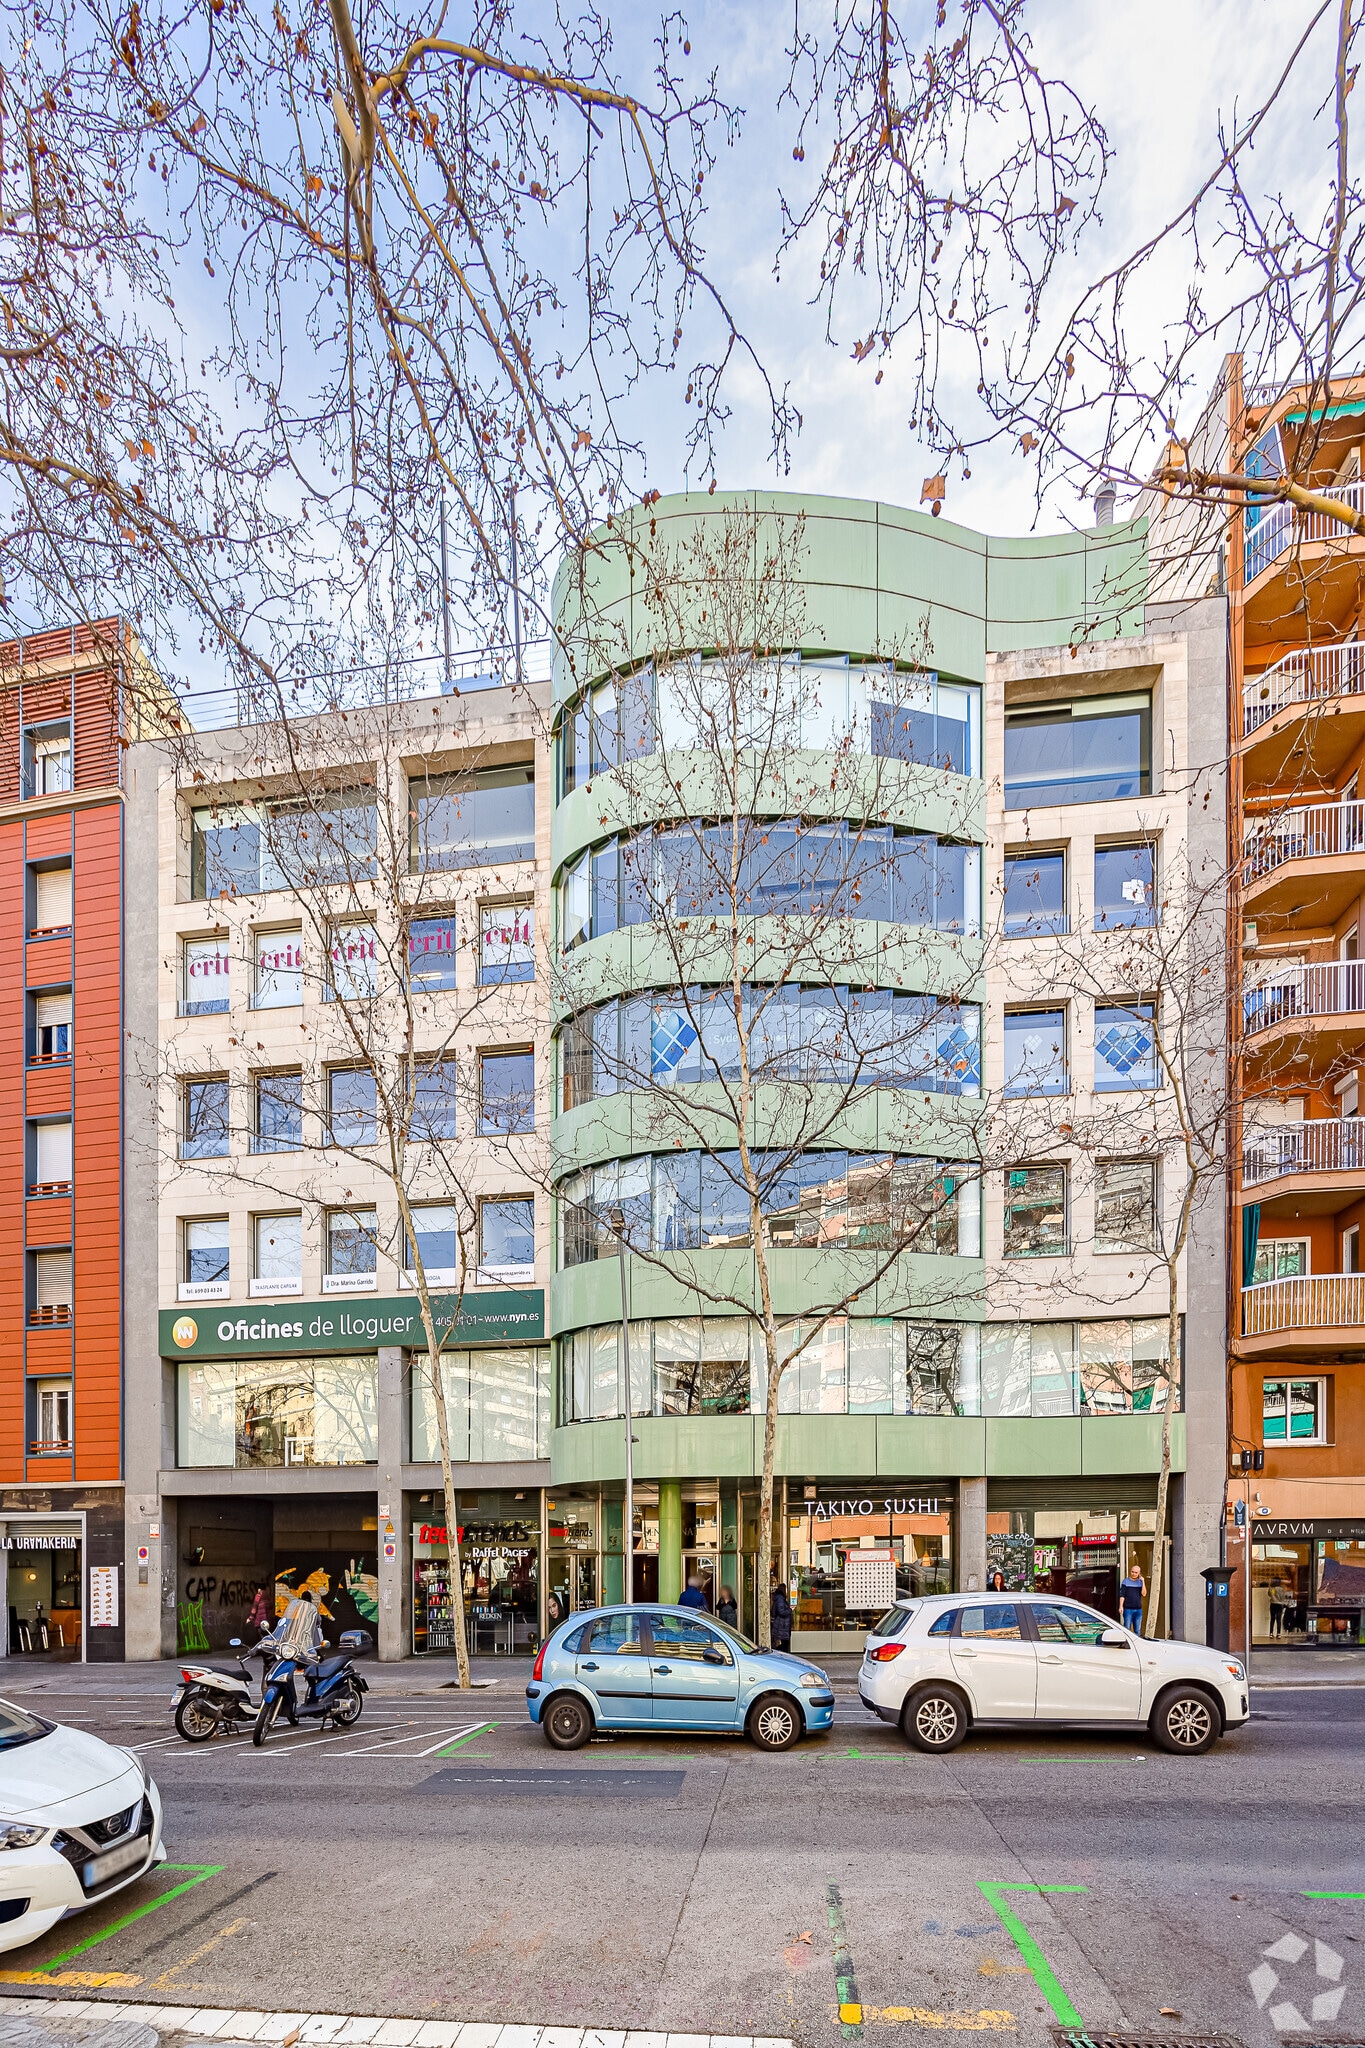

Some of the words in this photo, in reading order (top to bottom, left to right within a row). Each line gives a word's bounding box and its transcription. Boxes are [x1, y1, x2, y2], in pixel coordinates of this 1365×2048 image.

[409, 927, 453, 953] crit
[485, 918, 529, 944] crit
[260, 944, 301, 968] crit
[333, 936, 375, 962] crit
[189, 951, 229, 977] crit
[217, 1318, 304, 1341] Oficines
[308, 1315, 334, 1337] de
[339, 1313, 414, 1340] lloguer
[484, 1312, 540, 1324] www.nyn.es
[803, 1499, 874, 1516] TAKIYO
[884, 1498, 939, 1514] SUSHI
[1, 1538, 14, 1550] LA
[464, 1551, 472, 1559] by
[186, 1576, 217, 1602] CAP
[479, 1612, 503, 1621] REDKEN
